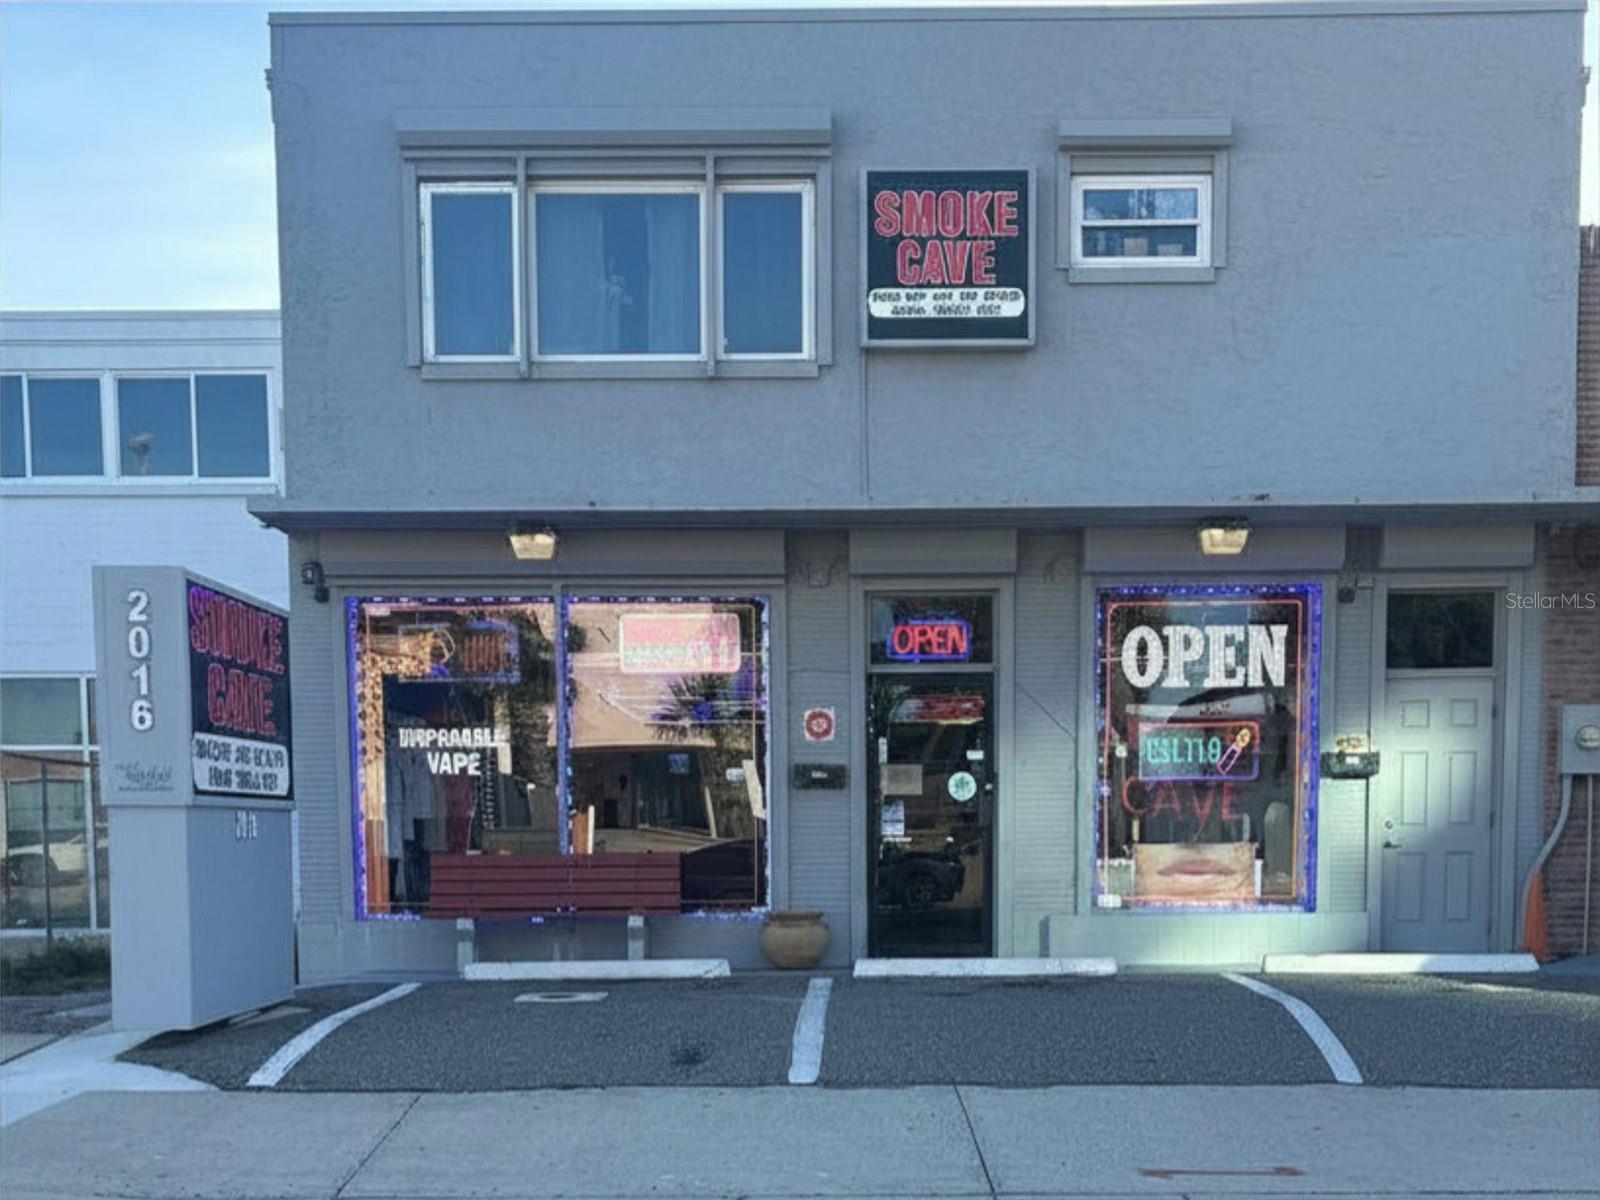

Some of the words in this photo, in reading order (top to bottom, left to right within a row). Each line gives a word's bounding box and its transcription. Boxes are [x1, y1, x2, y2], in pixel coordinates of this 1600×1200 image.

[874, 190, 1019, 237] SMOKE
[896, 239, 997, 285] CAVE
[127, 589, 154, 731] 2016
[893, 623, 967, 653] OPEN
[1121, 624, 1288, 688] OPEN
[427, 751, 481, 775] VAPE
